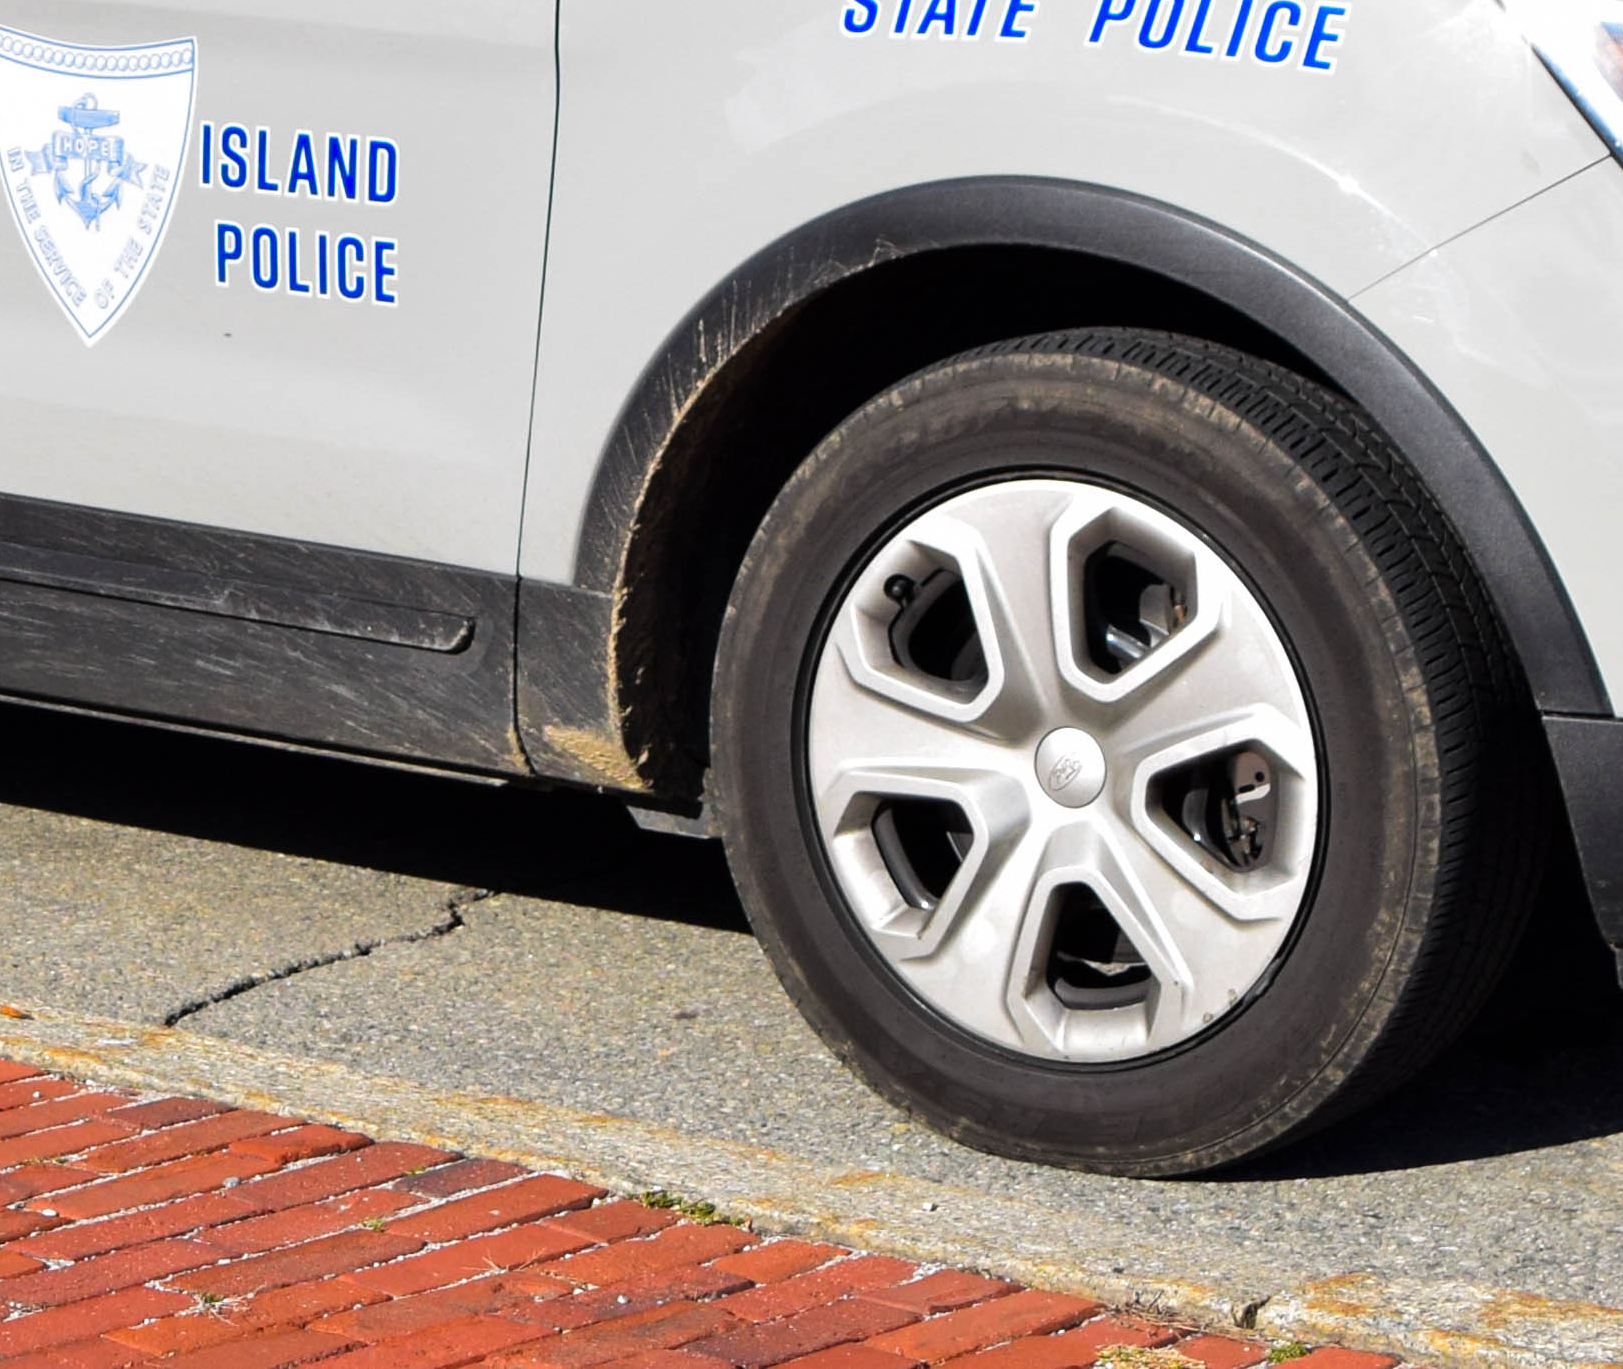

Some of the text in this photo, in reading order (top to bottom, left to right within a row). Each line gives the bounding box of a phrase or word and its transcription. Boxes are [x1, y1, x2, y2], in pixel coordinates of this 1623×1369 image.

[62, 136, 111, 157] HOPE
[202, 124, 397, 203] ISLAND
[136, 163, 171, 236] STATE
[216, 223, 396, 303] POLICE
